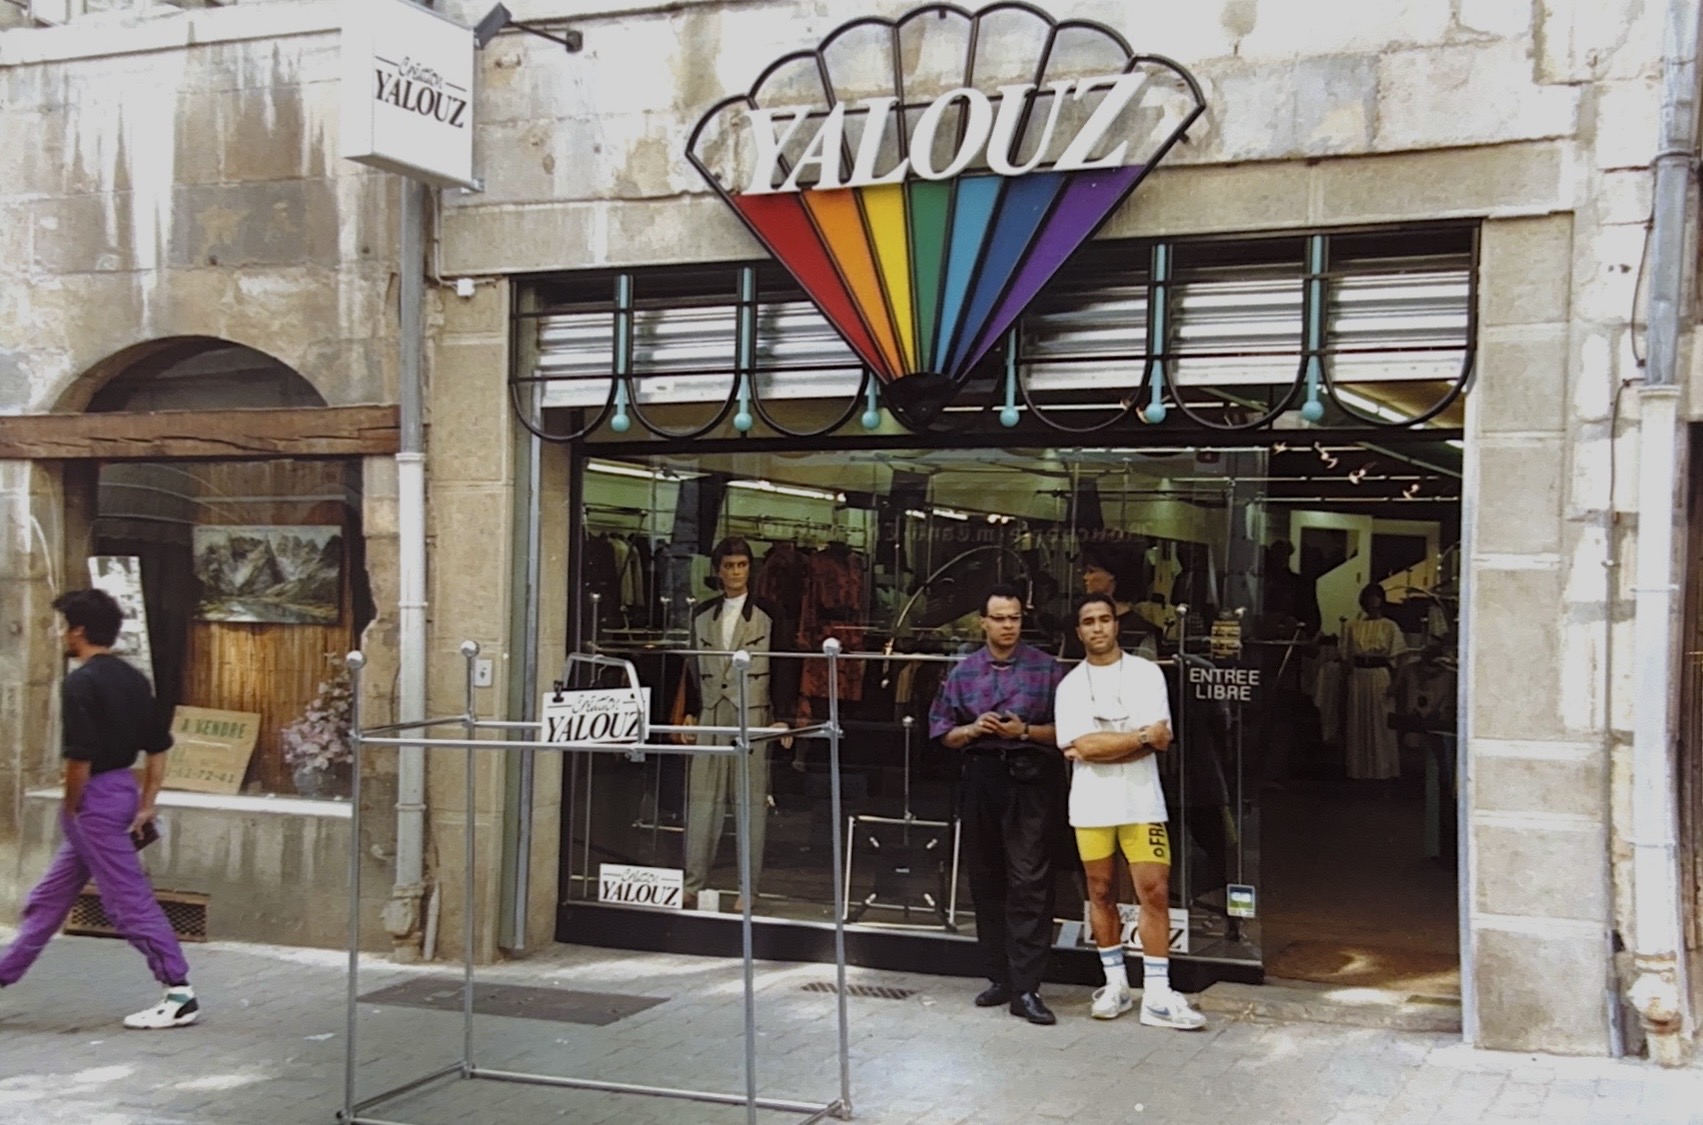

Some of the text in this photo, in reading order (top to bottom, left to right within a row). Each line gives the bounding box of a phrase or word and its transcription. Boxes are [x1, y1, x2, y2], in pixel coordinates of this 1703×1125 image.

[376, 69, 467, 128] YALOUZ
[741, 71, 1146, 196] YALOUZ
[1189, 667, 1260, 686] ENTREE
[1196, 684, 1252, 701] LIBRE
[546, 712, 640, 743] YALOUZ
[602, 880, 680, 907] YALOUZ
